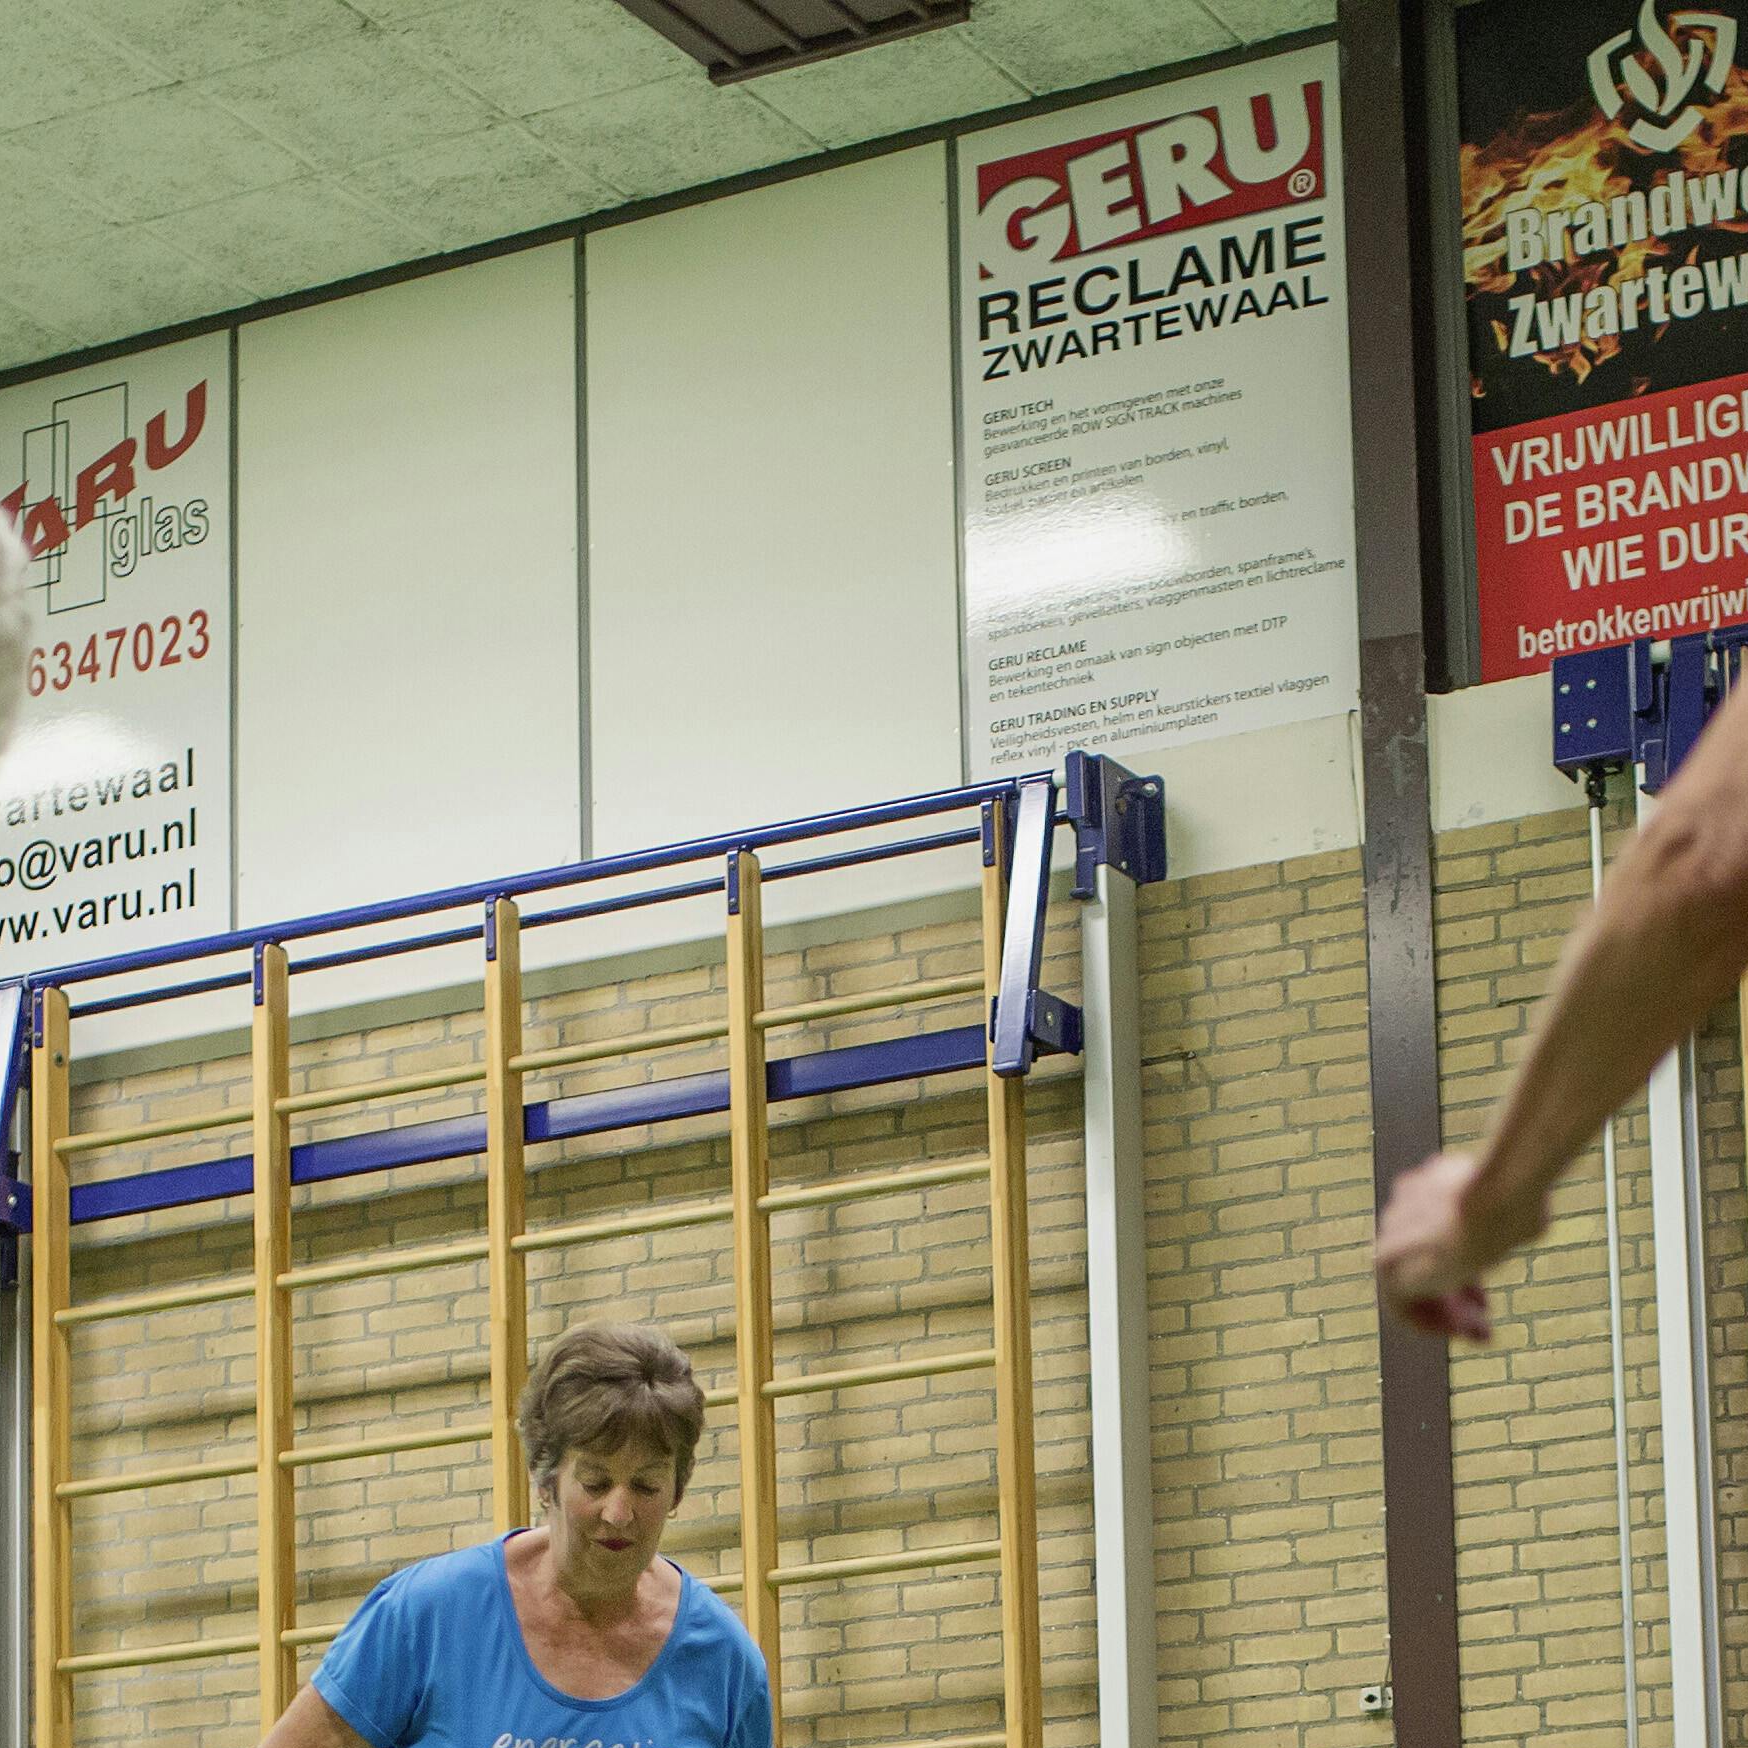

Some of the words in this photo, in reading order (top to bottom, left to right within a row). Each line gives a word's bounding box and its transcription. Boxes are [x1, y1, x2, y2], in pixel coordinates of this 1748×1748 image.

[979, 85, 1313, 273] GERU
[978, 215, 1326, 341] RECLAME
[982, 275, 1329, 382] ZWARTEWAAL
[982, 407, 1017, 424] GERU
[1019, 398, 1053, 416] TECH
[983, 419, 1047, 440] Bewerking
[1050, 414, 1066, 425] en
[1069, 408, 1089, 420] het
[1166, 385, 1191, 398] met
[984, 468, 1018, 486] GERU
[1022, 458, 1071, 478] SCREEN
[110, 496, 210, 579] glas
[1505, 492, 1564, 545] DE
[1562, 533, 1646, 591] WIE
[26, 608, 211, 697] 6347023
[988, 666, 1053, 687] Bewerking
[1056, 662, 1071, 672] en
[1119, 648, 1142, 659] van
[1144, 642, 1171, 656] sign
[1173, 630, 1230, 648] objecten
[1233, 624, 1257, 636] met
[1261, 616, 1287, 632] DTP
[988, 654, 1023, 671] GERU
[1026, 640, 1086, 662] RECLAME
[988, 692, 1005, 703] en
[1007, 672, 1095, 698] tekentechniek
[990, 716, 1025, 733] GERU
[1027, 704, 1087, 724] TRADING
[1090, 700, 1106, 713] EN
[1109, 689, 1159, 709] SUPPLY
[1103, 713, 1135, 726] helm
[1138, 709, 1154, 720] en
[1156, 694, 1231, 715] keurstickers
[1234, 682, 1274, 700] textiel
[990, 752, 1023, 764] reflex
[1026, 742, 1056, 757] vinyl
[1091, 734, 1107, 744] en
